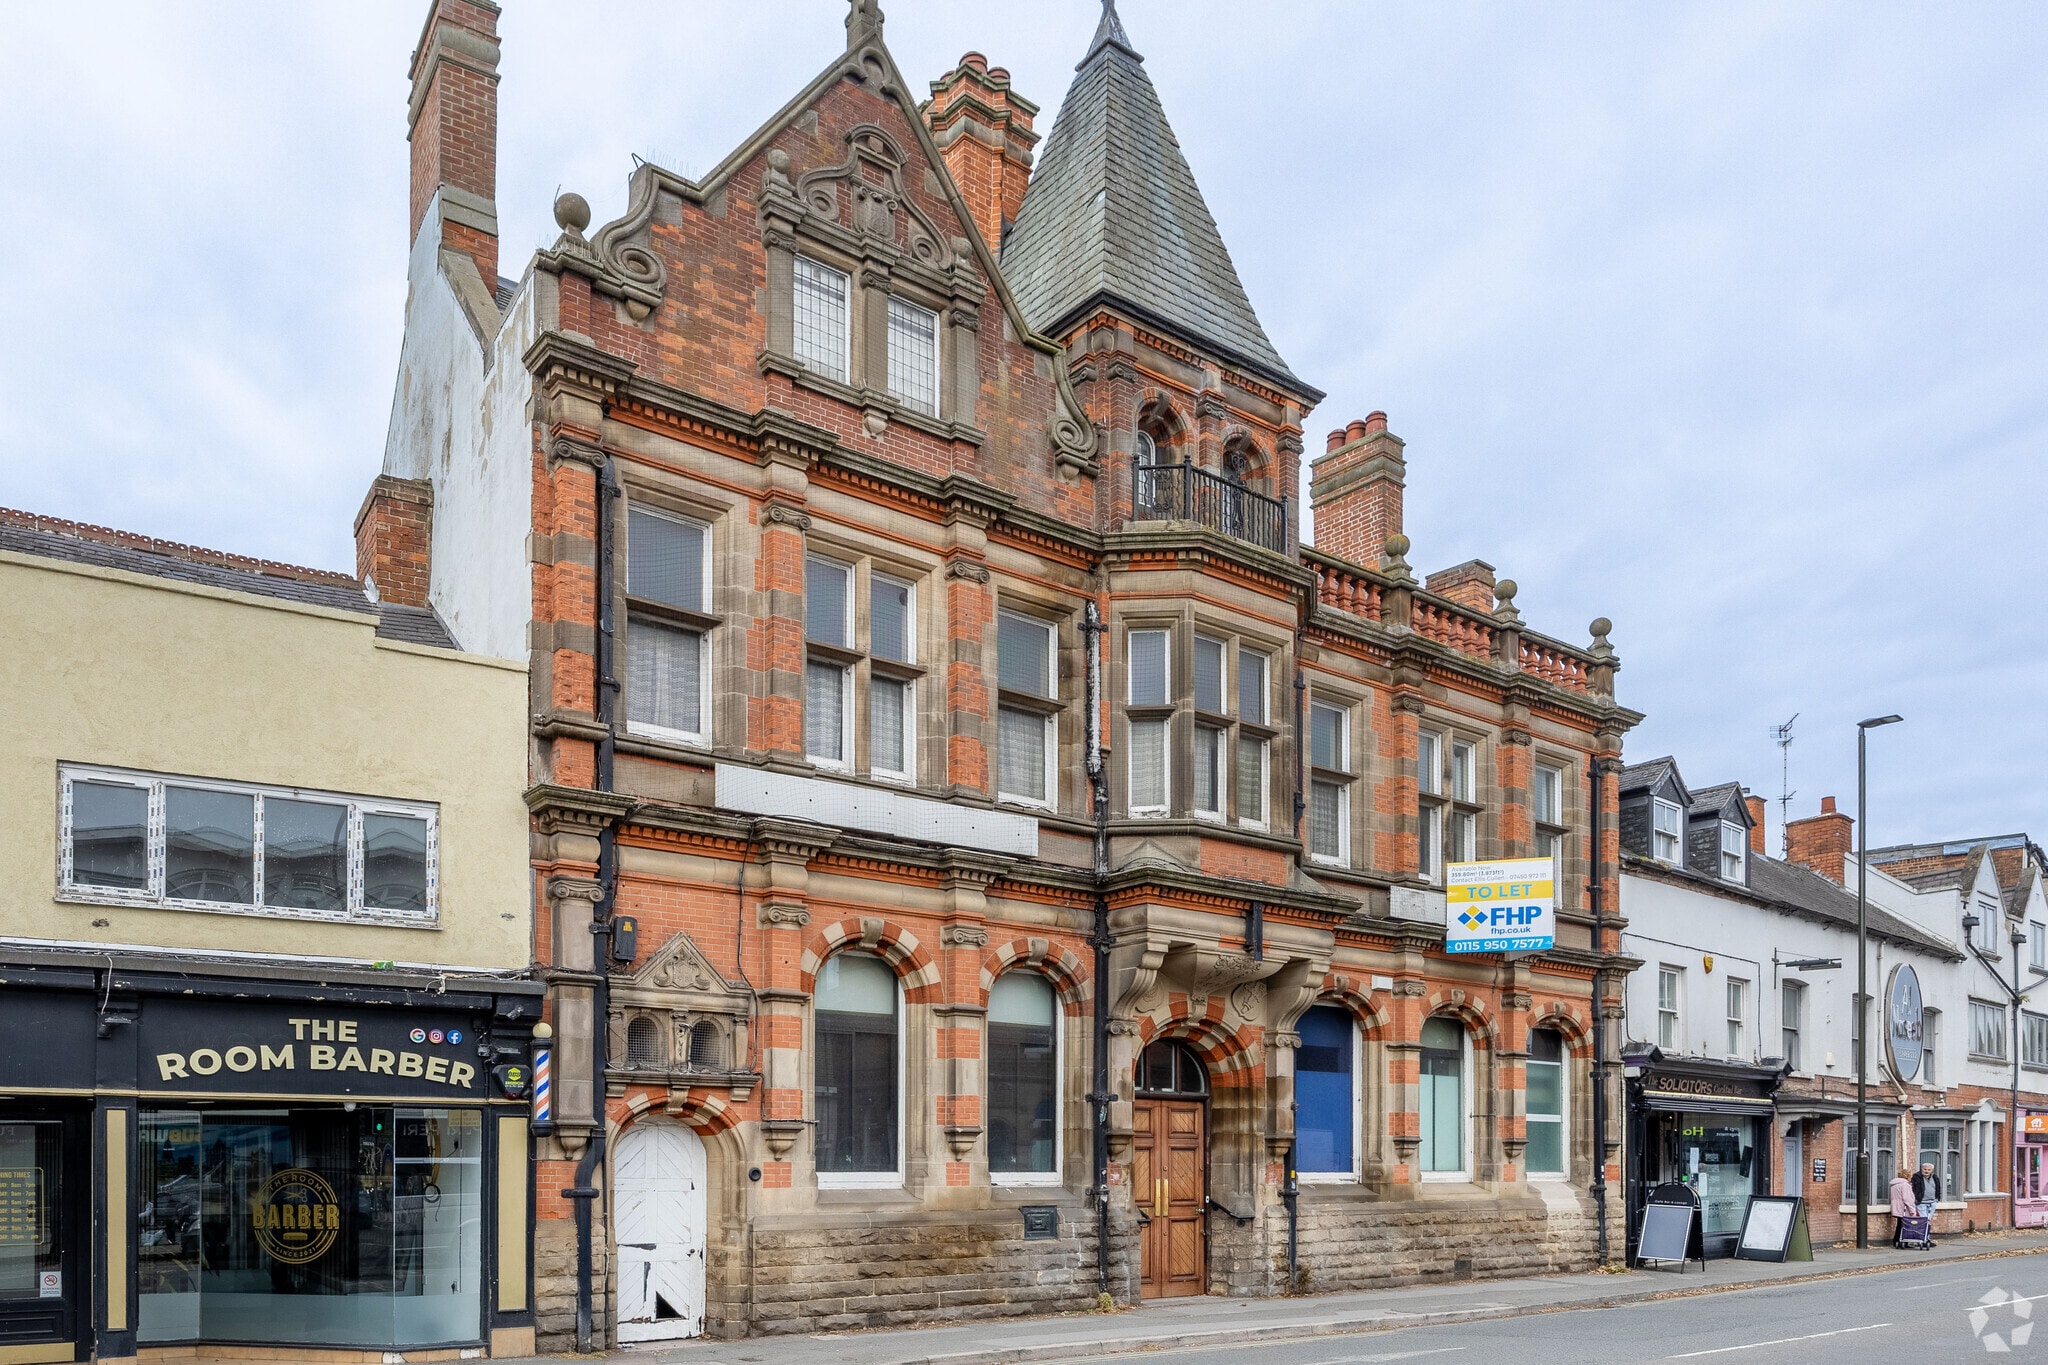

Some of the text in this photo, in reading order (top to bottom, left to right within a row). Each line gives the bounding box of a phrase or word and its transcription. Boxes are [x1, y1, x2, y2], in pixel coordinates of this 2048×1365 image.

[1466, 884, 1533, 899] TO LET
[1490, 906, 1542, 926] FHP
[1491, 926, 1531, 935] fhp.co.uk
[1454, 938, 1544, 951] 0115 950 7577
[288, 1018, 358, 1043] THE
[156, 1044, 475, 1089] ROOM BARBER
[1647, 1076, 1658, 1086] The
[1659, 1077, 1713, 1095] SOLICITORS
[269, 1173, 323, 1192] THE ROOM
[252, 1202, 340, 1229] BARBER
[275, 1246, 317, 1258] SINCE 2021
